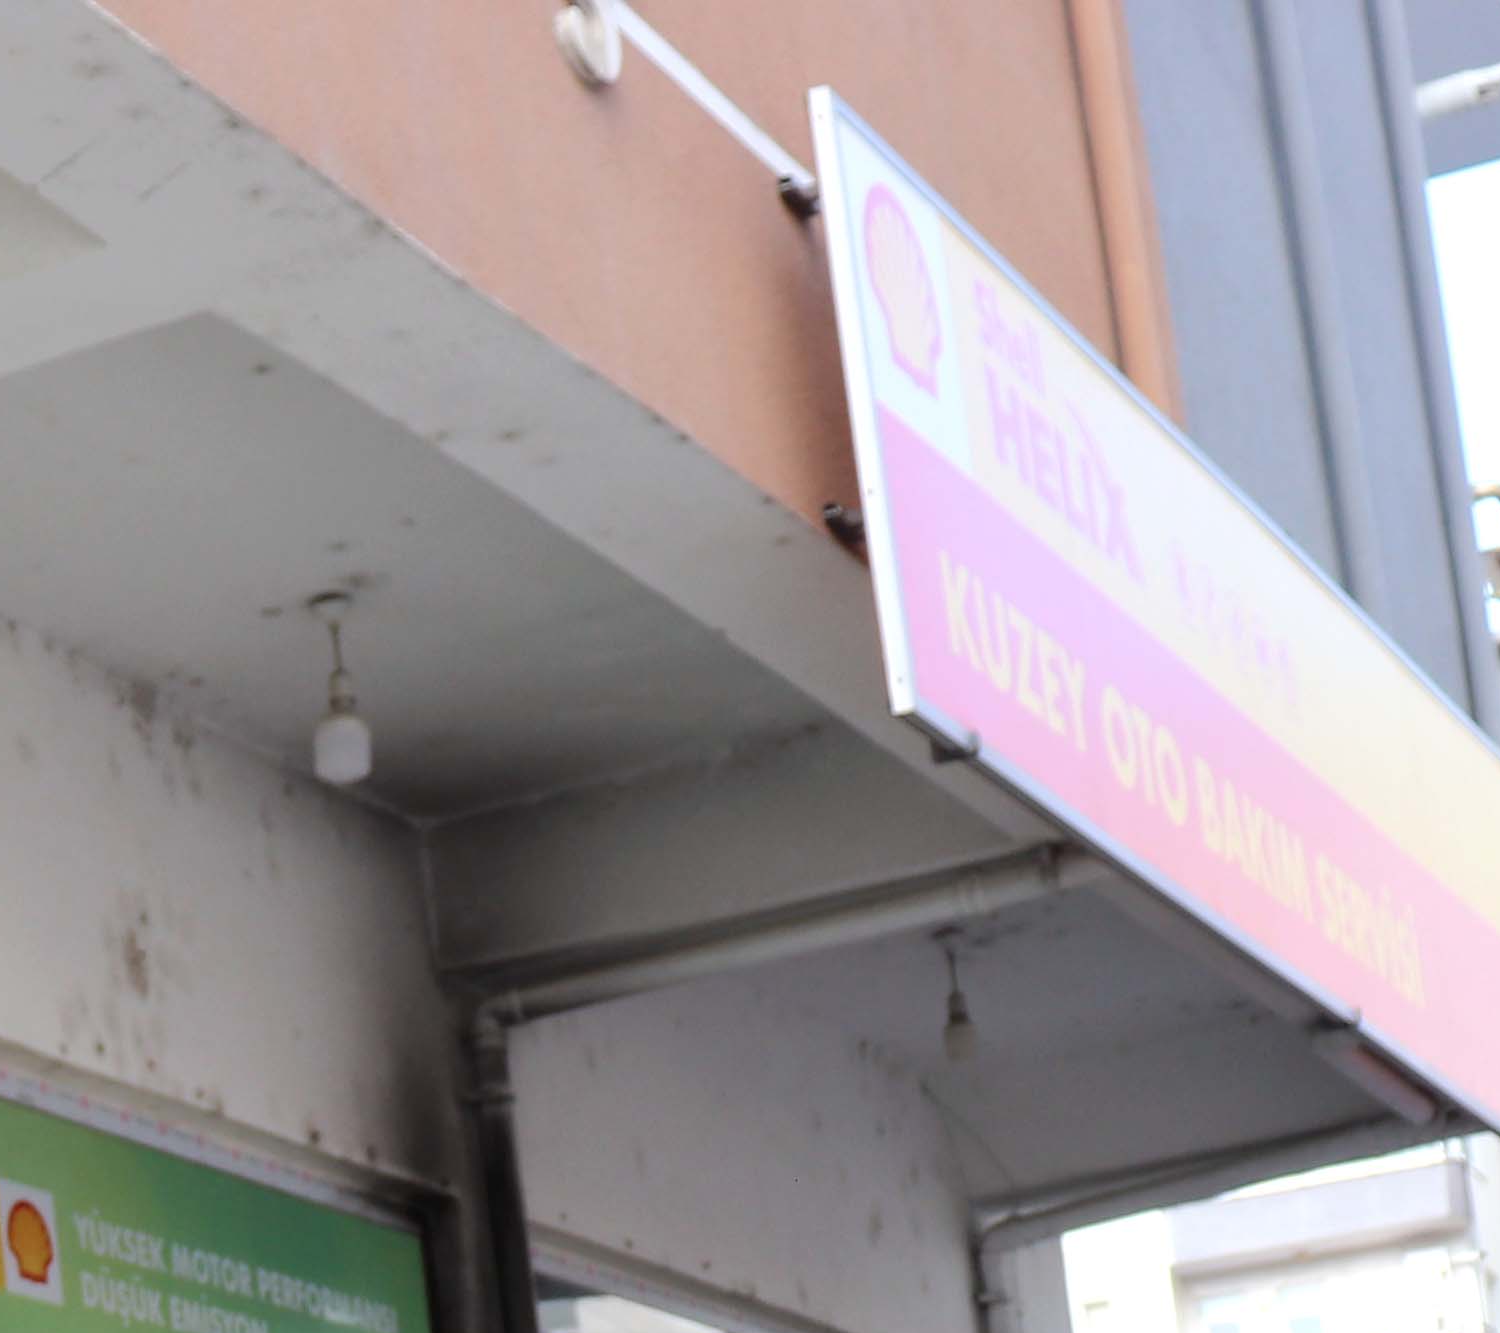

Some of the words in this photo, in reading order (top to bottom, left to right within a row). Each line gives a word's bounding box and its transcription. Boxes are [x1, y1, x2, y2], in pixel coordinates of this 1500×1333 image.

[937, 546, 1090, 752] KUZEY
[1100, 682, 1189, 828] OTO
[1195, 750, 1316, 926] BAKIM
[71, 1207, 169, 1273] YÜKSEK
[171, 1242, 254, 1302] MOTOR
[79, 1263, 165, 1329] DÜŞÜK
